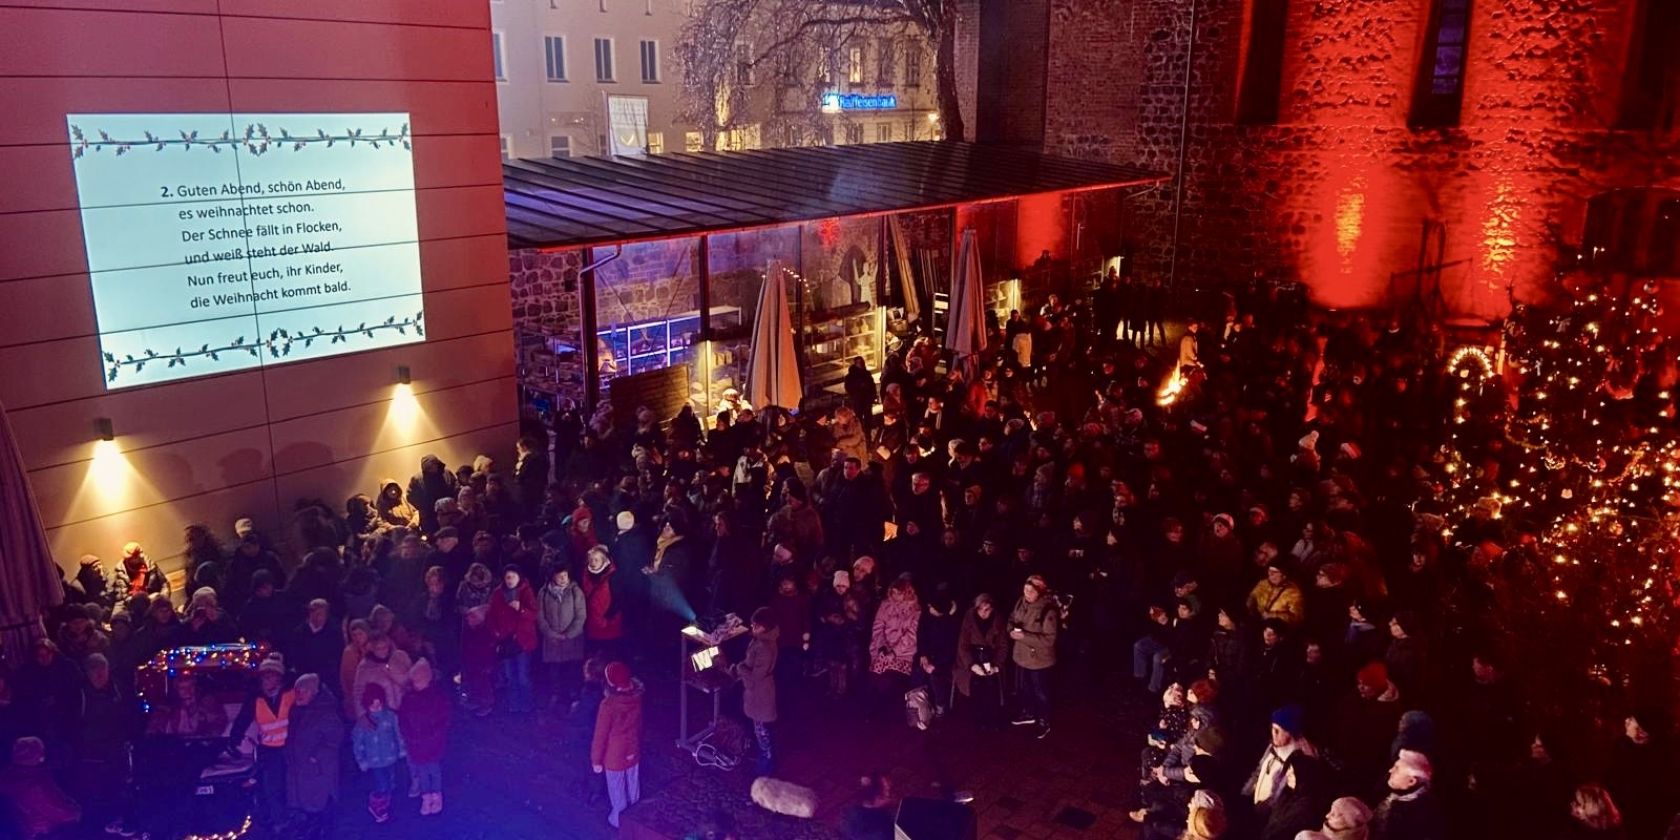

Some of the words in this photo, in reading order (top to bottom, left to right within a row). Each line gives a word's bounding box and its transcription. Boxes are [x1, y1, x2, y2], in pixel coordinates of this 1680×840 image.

[161, 186, 174, 198] 2.
[177, 185, 217, 197] Guten
[221, 182, 265, 195] Abend,
[268, 181, 302, 193] schön
[305, 178, 346, 191] Abend,
[179, 209, 193, 220] es
[196, 204, 273, 218] weihnachtet
[276, 202, 315, 214] schon.
[182, 230, 205, 242] Der
[208, 228, 253, 240] Schnee
[256, 224, 280, 236] fällt
[282, 224, 293, 234] in
[296, 221, 342, 233] Flocken,
[185, 251, 210, 264] und
[213, 248, 242, 260] weiß
[247, 246, 278, 258] steht
[279, 244, 299, 256] der
[301, 241, 334, 253] Wald.
[187, 275, 214, 287] Nun
[217, 272, 248, 284] freut
[251, 268, 283, 280] euch,
[286, 265, 301, 277] ihr
[305, 262, 343, 275] Kinder,
[190, 296, 210, 309] die
[213, 289, 279, 306] Weihnacht
[281, 284, 322, 298] kommt
[324, 281, 351, 294] bald.
